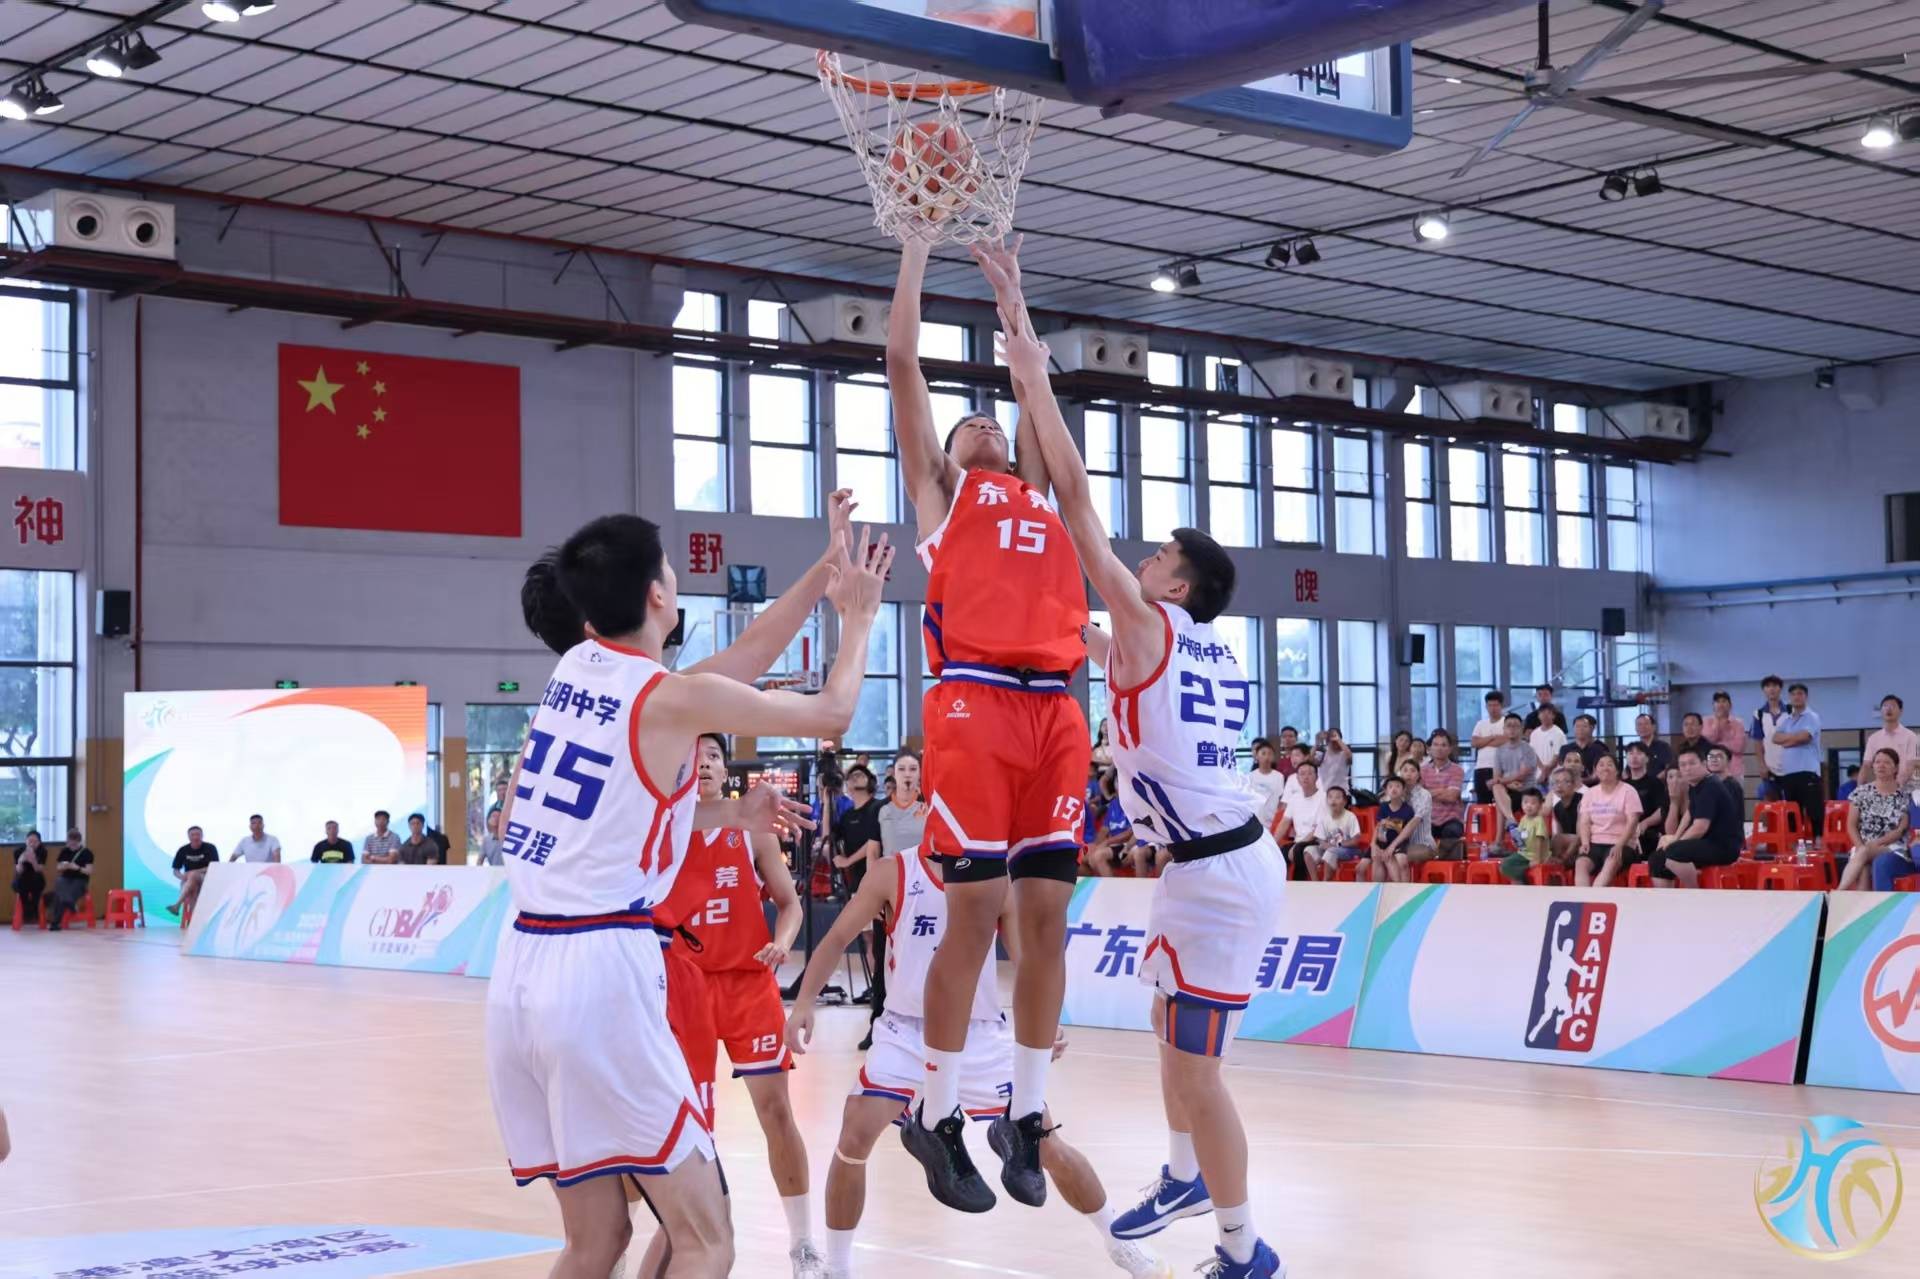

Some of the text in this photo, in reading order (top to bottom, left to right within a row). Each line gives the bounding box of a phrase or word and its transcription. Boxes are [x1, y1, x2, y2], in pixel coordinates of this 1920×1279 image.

[14, 495, 63, 545] 神
[996, 518, 1046, 554] 15
[689, 533, 723, 574] 野
[1180, 671, 1250, 731] 23
[515, 728, 614, 821] 25
[728, 775, 741, 788] VS
[1053, 795, 1080, 820] 15
[912, 914, 938, 937] 东
[1569, 911, 1608, 1043] BAHKC
[752, 1033, 777, 1053] 12
